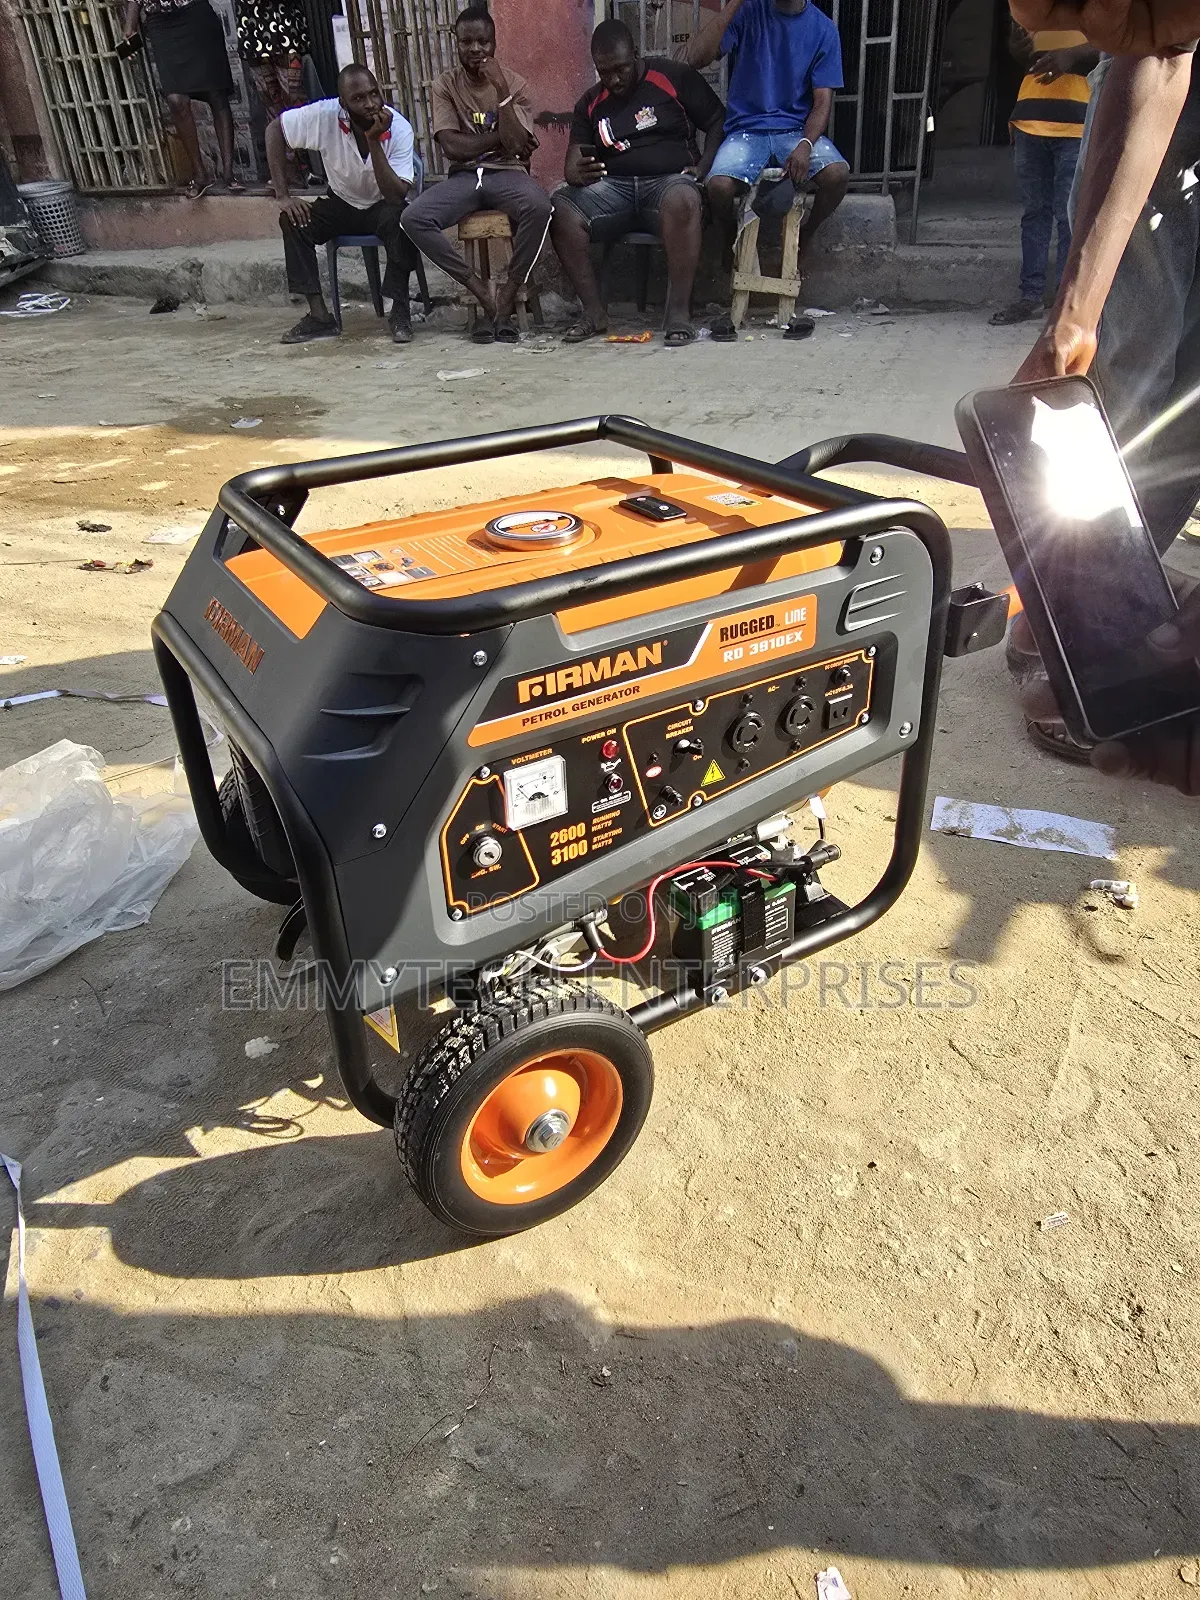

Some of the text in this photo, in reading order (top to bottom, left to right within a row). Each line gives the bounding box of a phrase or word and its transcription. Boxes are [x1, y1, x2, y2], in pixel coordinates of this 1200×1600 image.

[719, 606, 807, 643] RUGGED LINE
[203, 596, 265, 676] FIRMAN
[723, 646, 744, 663] RD
[517, 641, 663, 704] FIRMAN
[521, 685, 641, 727] PETROL GENERATOR
[665, 725, 694, 740] BREAKER
[667, 718, 693, 731] CIRCUIT
[581, 727, 617, 744] POWER ON
[510, 748, 553, 765] VOLTMETER
[592, 809, 621, 825] RUNNING
[491, 822, 508, 835] START
[549, 821, 586, 848] 2600
[591, 820, 613, 832] WATTS
[592, 827, 623, 844] STARTING
[592, 838, 613, 850] WATTS
[550, 839, 588, 866] 3100
